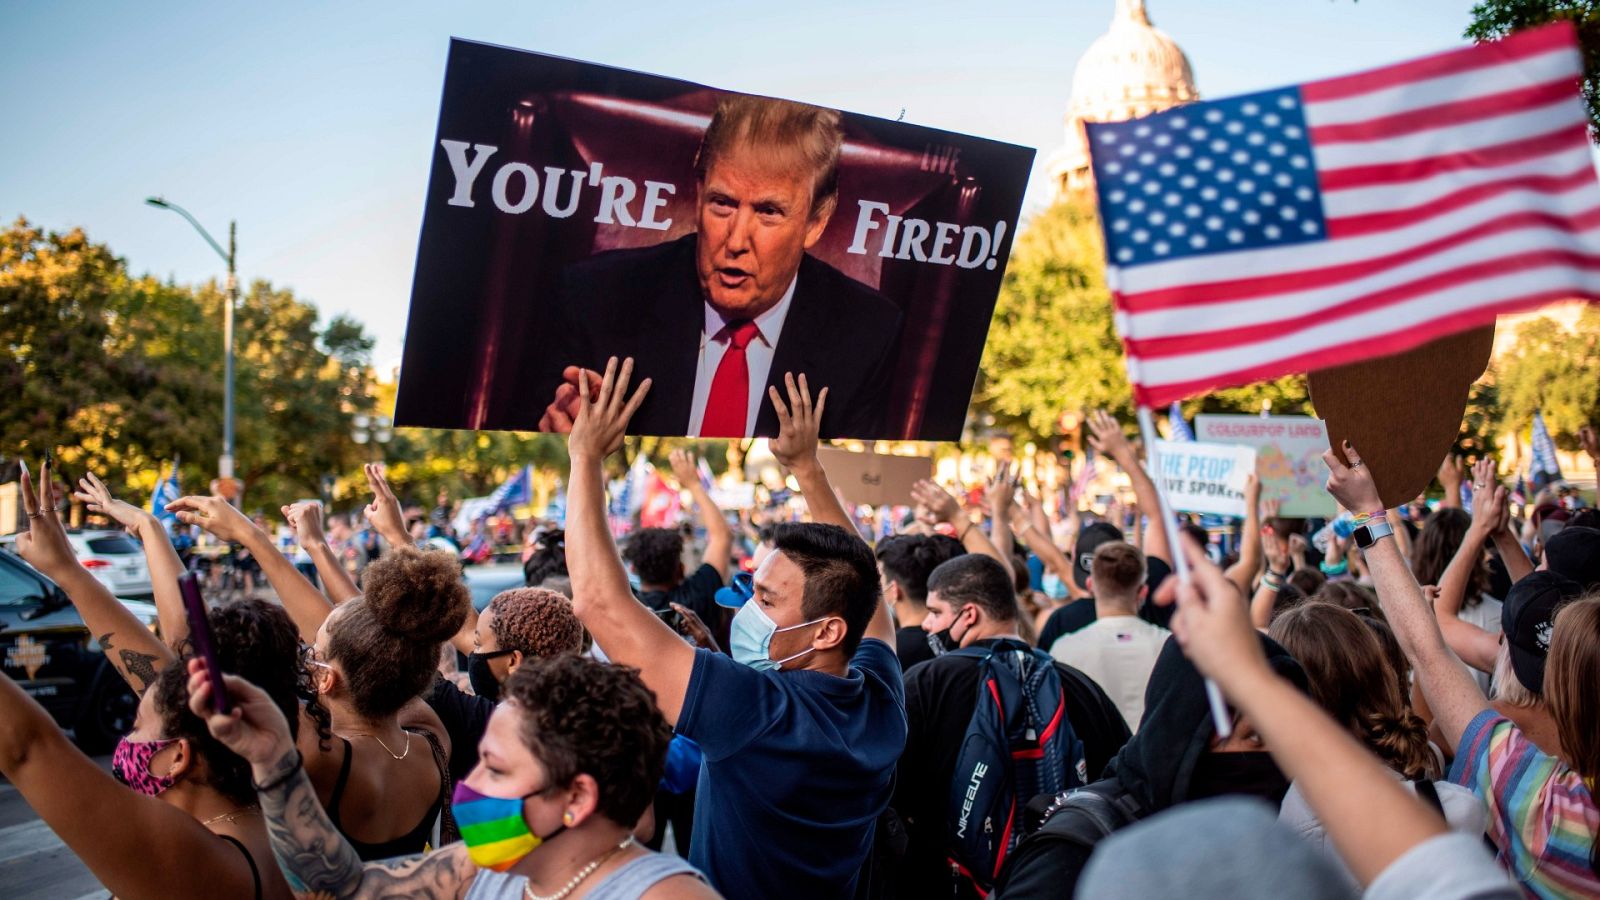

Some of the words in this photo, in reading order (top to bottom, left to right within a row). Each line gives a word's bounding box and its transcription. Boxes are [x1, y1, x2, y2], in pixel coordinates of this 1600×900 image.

[440, 138, 677, 231] YOU'RE
[920, 143, 961, 175] LIVE
[847, 199, 1008, 272] FIRED!
